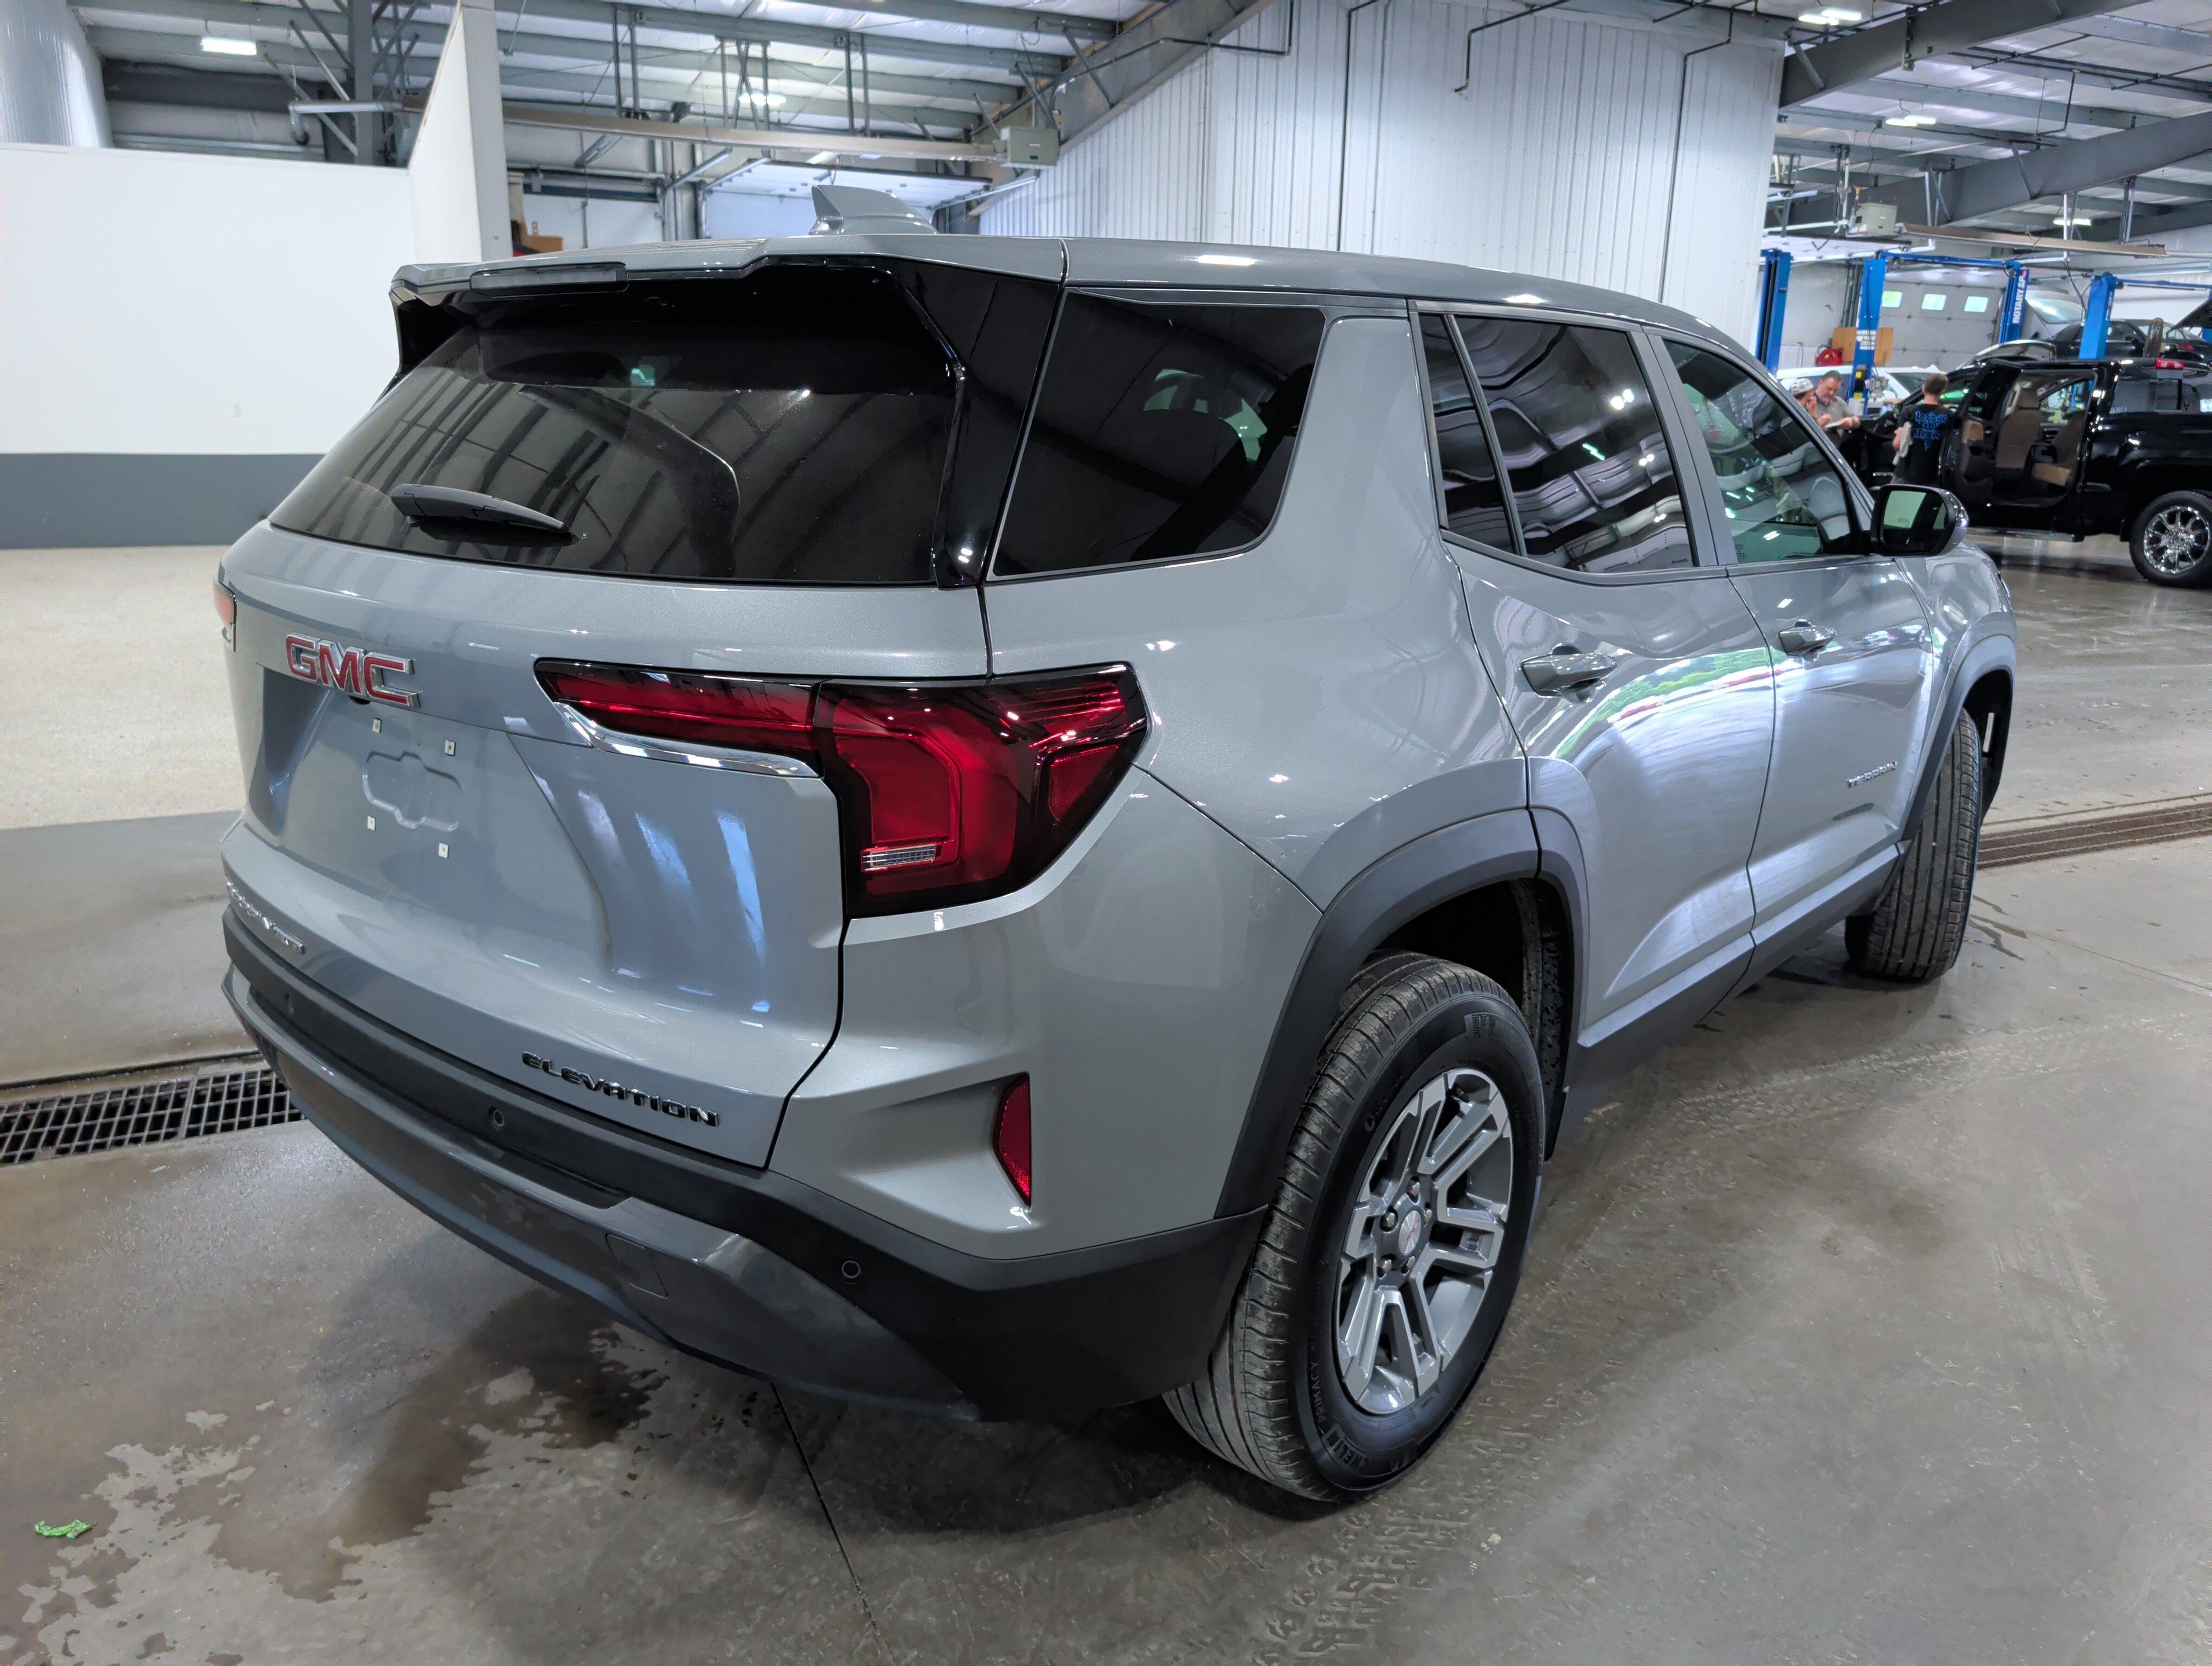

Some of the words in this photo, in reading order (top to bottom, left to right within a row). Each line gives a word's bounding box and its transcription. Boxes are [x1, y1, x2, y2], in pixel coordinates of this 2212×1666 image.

[2012, 290, 2024, 324] ROTARY
[286, 632, 422, 708] GMC
[1846, 761, 1898, 787] TERRAIN
[522, 1050, 719, 1126] ELEVATION
[1310, 1361, 1326, 1424] PRIMACY
